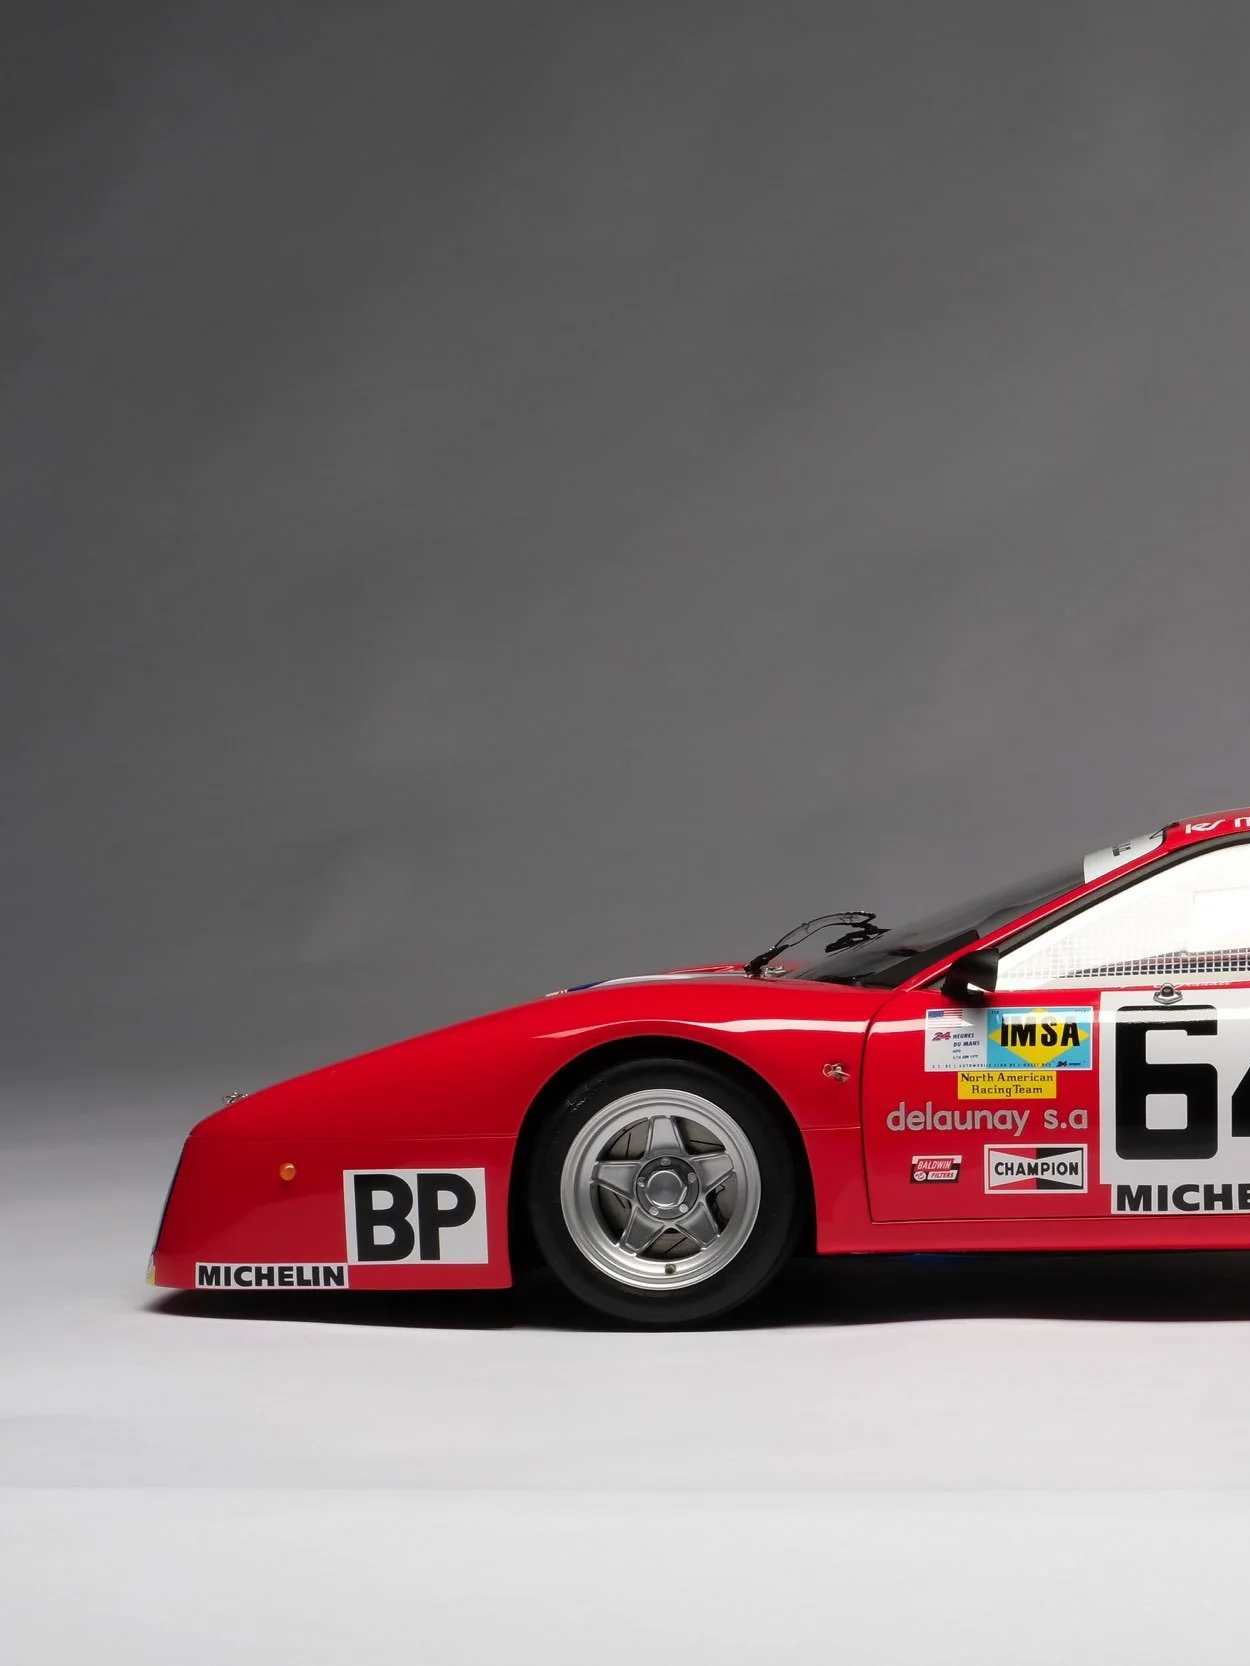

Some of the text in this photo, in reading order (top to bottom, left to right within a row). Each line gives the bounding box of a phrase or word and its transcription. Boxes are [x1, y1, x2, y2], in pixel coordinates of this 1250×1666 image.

[932, 1031, 951, 1042] 24
[1000, 1015, 1081, 1047] IMSA
[960, 1072, 1053, 1082] North American
[971, 1084, 1043, 1098] Racing Team
[886, 1101, 1030, 1137] delaunay
[917, 1160, 952, 1170] BALDWIN
[994, 1161, 1079, 1176] CHAMPION
[930, 1171, 955, 1179] FILTERS
[353, 1172, 477, 1262] BP
[197, 1265, 346, 1287] MICHELIN
